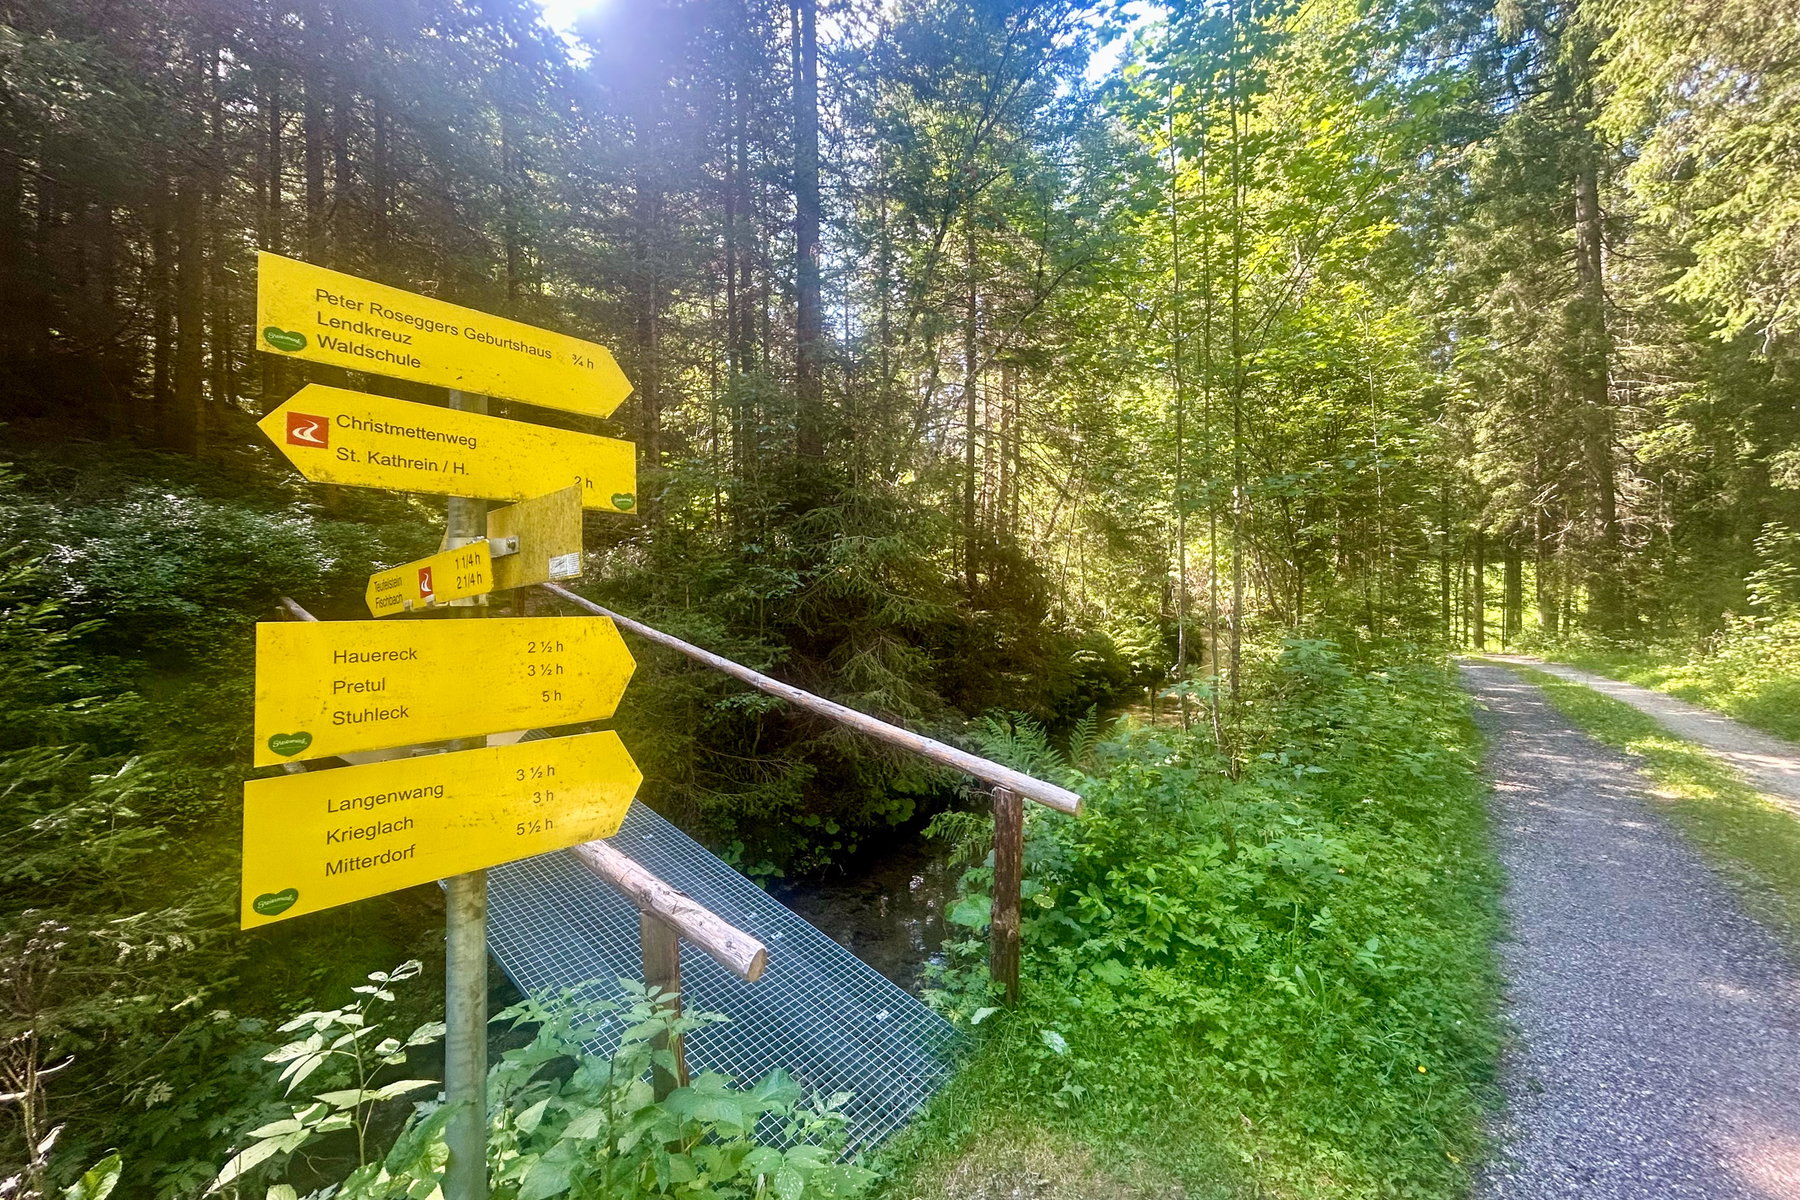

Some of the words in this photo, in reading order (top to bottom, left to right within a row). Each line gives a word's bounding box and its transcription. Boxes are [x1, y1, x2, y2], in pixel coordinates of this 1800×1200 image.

[316, 288, 363, 312] Peter
[370, 302, 458, 336] Roseggers
[464, 327, 552, 359] Geburtshaus
[587, 358, 594, 369] h
[317, 311, 412, 345] Lendkreuz
[317, 334, 421, 369] Waldschule
[336, 413, 477, 449] Christmettenweg
[336, 447, 361, 463] St.
[367, 451, 438, 472] Kathrein
[453, 462, 469, 476] H.
[586, 478, 592, 488] h
[376, 593, 403, 608] Fischbach
[333, 648, 417, 664] Hauereck
[527, 642, 536, 653] 2
[556, 641, 563, 652] h
[333, 678, 385, 694] Pretul
[527, 665, 536, 676] 3
[556, 664, 563, 675] h
[332, 705, 409, 725] Stuhleck
[542, 691, 550, 702] 5
[554, 690, 561, 701] h
[327, 784, 444, 813] Langenwang
[516, 769, 525, 781] 3
[547, 765, 555, 777] h
[326, 817, 413, 845] Krieglach
[533, 791, 542, 803] 3
[546, 790, 554, 801] h
[325, 844, 416, 876] Mitterdorf
[516, 823, 525, 836] 5
[545, 818, 553, 830] h
